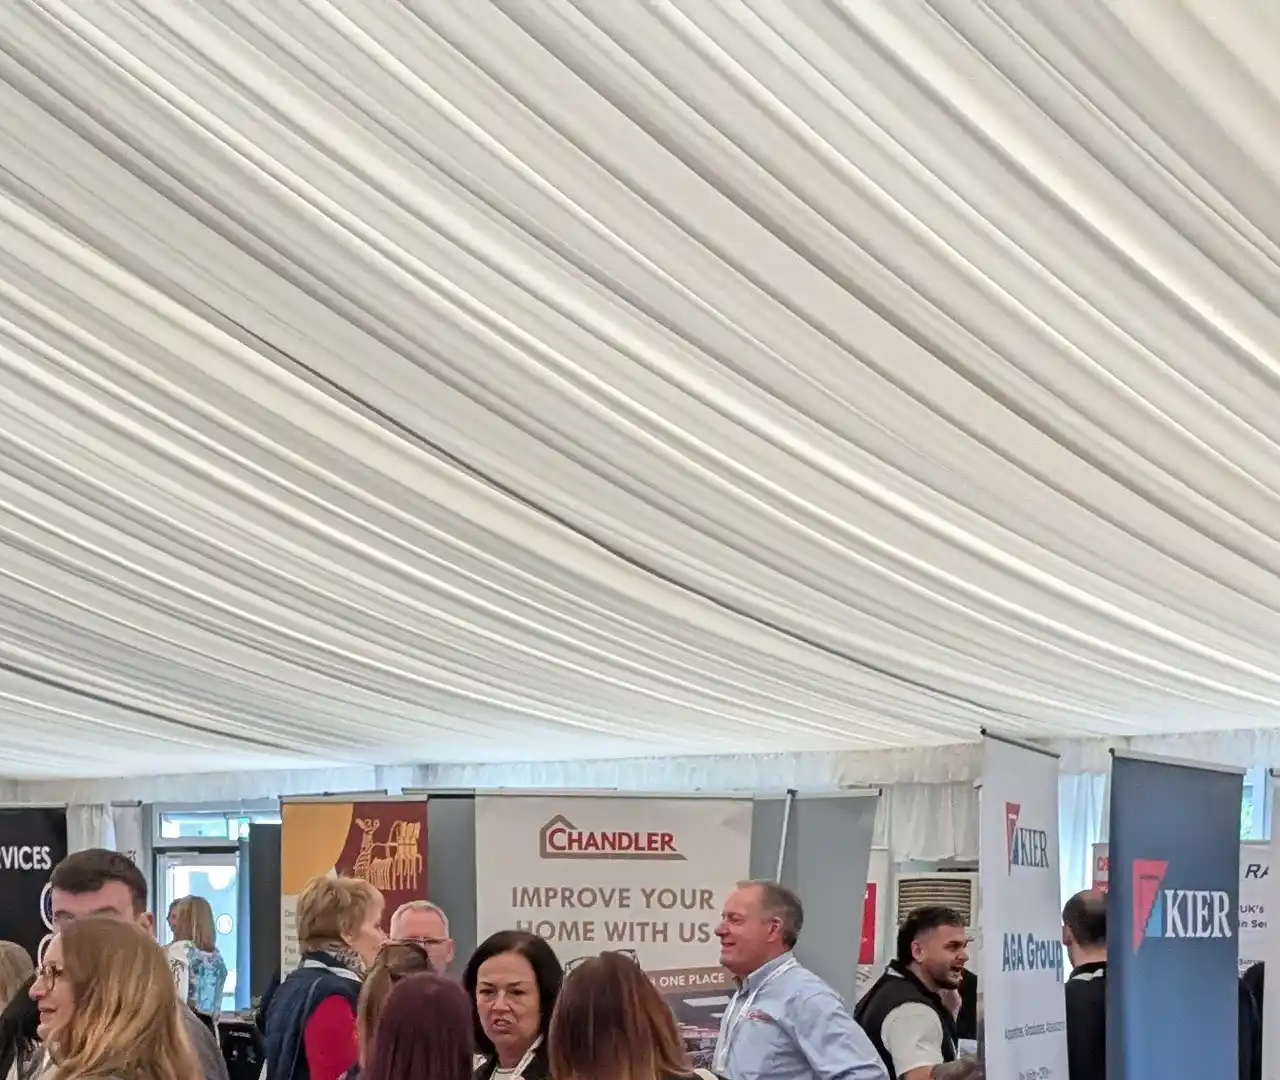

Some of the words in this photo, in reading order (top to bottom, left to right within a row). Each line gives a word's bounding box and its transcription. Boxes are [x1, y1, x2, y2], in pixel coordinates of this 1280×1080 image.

[548, 828, 678, 851] CHANDLER
[1020, 827, 1050, 869] KIER
[512, 887, 631, 908] IMPROVE
[640, 888, 715, 910] YOUR
[1164, 889, 1232, 938] KIER
[517, 920, 595, 942] HOME
[604, 921, 668, 943] WITH
[679, 923, 711, 943] US
[1027, 932, 1064, 982] Group
[659, 976, 685, 987] ONE
[688, 972, 725, 986] PLACE
